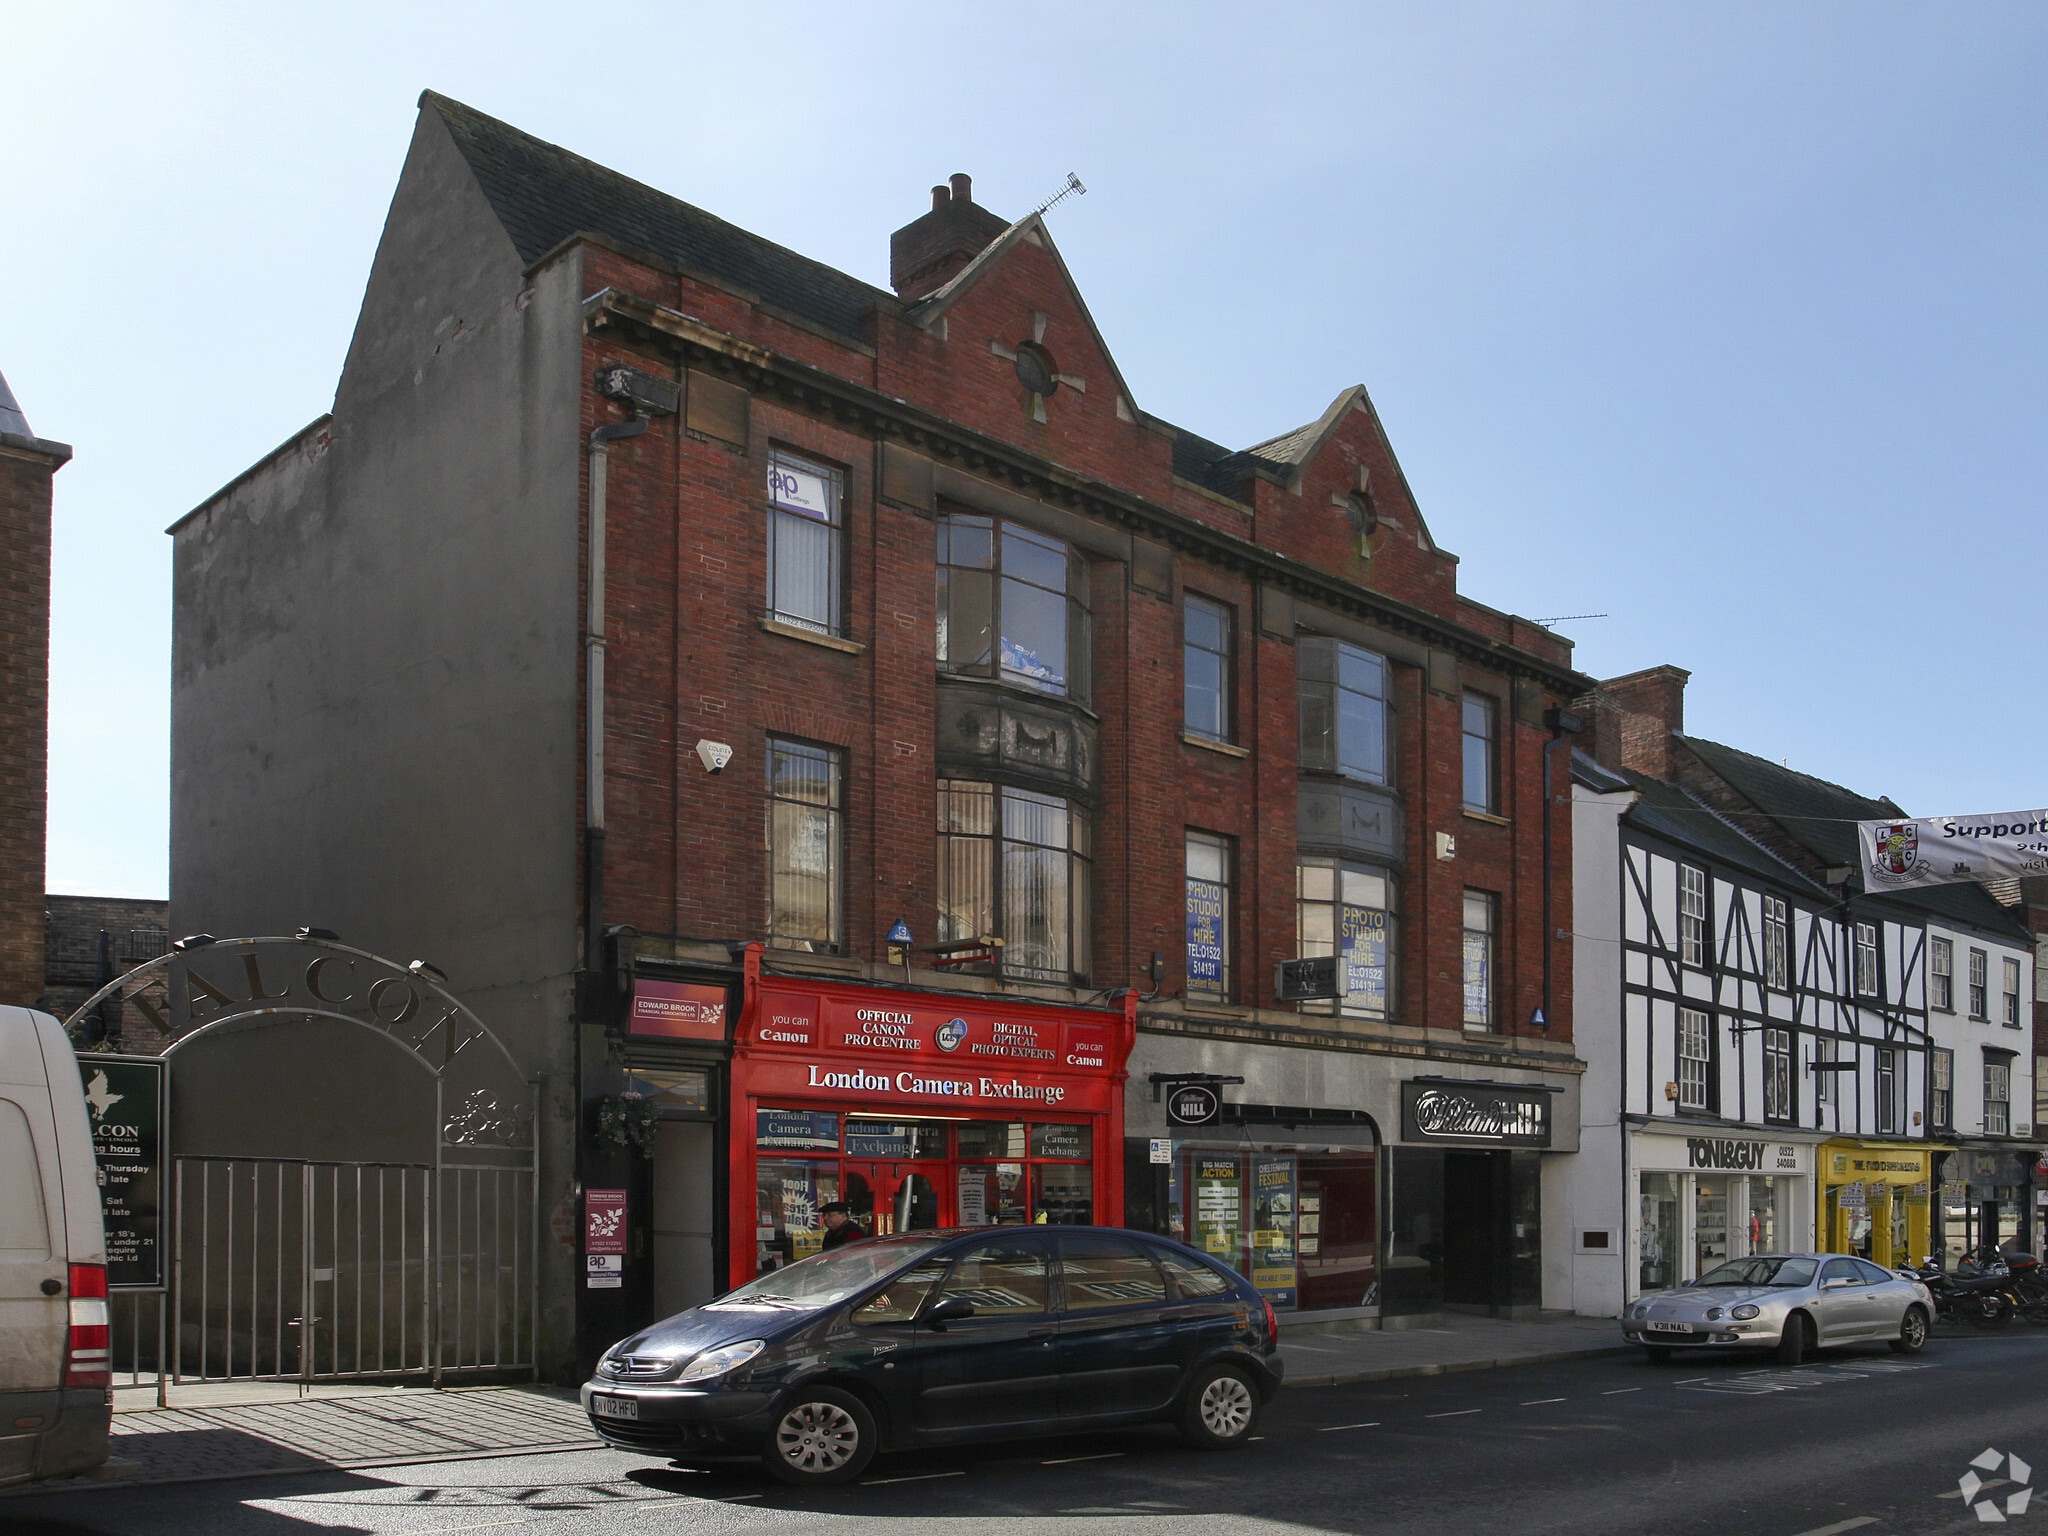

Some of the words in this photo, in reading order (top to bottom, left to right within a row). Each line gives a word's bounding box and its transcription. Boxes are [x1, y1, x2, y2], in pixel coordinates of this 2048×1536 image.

[768, 470, 799, 498] ap
[1943, 818, 2048, 838] Support
[2017, 842, 2048, 852] 9th
[1187, 881, 1220, 901] PHOTO
[1187, 898, 1220, 917] STUDIO
[1197, 916, 1211, 928] FOR
[1343, 907, 1383, 927] PHOTO
[1193, 927, 1215, 945] HIRE
[1342, 922, 1385, 943] STUDIO
[1354, 940, 1371, 952] FOR
[1463, 932, 1486, 948] PHOTO
[1187, 943, 1221, 960] TEL:01522
[1463, 946, 1487, 962] STUDIO
[1350, 951, 1375, 967] HIRE
[1193, 960, 1215, 976] 514131
[1347, 965, 1382, 980] EL:01522
[1350, 979, 1376, 992] 514131
[123, 951, 486, 1073] FALCON
[638, 1001, 669, 1010] EDWARD
[670, 1003, 696, 1013] BROOK
[771, 1015, 790, 1026] you
[792, 1017, 809, 1026] can
[856, 1008, 914, 1025] OFFICIAL
[759, 1028, 809, 1044] Canon
[862, 1022, 906, 1037] CANON
[993, 1022, 1038, 1037] DIGITAL,
[844, 1033, 871, 1046] PRO
[872, 1036, 921, 1050] CENTRE
[992, 1034, 1037, 1048] OPTICAL
[1075, 1042, 1091, 1052] you
[1090, 1043, 1103, 1052] can
[971, 1043, 1009, 1056] PHOTO
[1010, 1047, 1056, 1060] EXPERTS
[1066, 1054, 1103, 1067] Canon
[807, 1065, 890, 1092] London
[895, 1071, 974, 1098] Camera
[978, 1077, 1065, 1105] Exchange
[768, 1111, 810, 1122] London
[1181, 1103, 1206, 1116] HILL
[1414, 1090, 1501, 1134] William
[1502, 1101, 1545, 1135] HILL
[767, 1122, 812, 1135] Camera
[828, 1119, 879, 1135] Lndon
[886, 1122, 939, 1137] Cmera
[763, 1135, 816, 1149] Exchange
[1044, 1134, 1079, 1145] Camera
[110, 1144, 141, 1153] hours
[1040, 1145, 1082, 1158] Exchange
[1686, 1138, 1766, 1171] TONI&GUY
[1778, 1146, 1795, 1157] 01522
[104, 1164, 149, 1174] Thursday
[1202, 1168, 1235, 1178] ACTION
[1258, 1161, 1290, 1174] CHELTENHAM
[111, 1175, 130, 1183] late
[1258, 1171, 1290, 1187] FESTIVAL
[106, 1197, 123, 1206] Sat
[112, 1208, 131, 1216] late
[117, 1230, 136, 1238] 18's
[114, 1238, 141, 1246] under
[589, 1256, 606, 1270] ap
[1670, 1323, 1688, 1332] NAL
[619, 1399, 637, 1417] HFO
